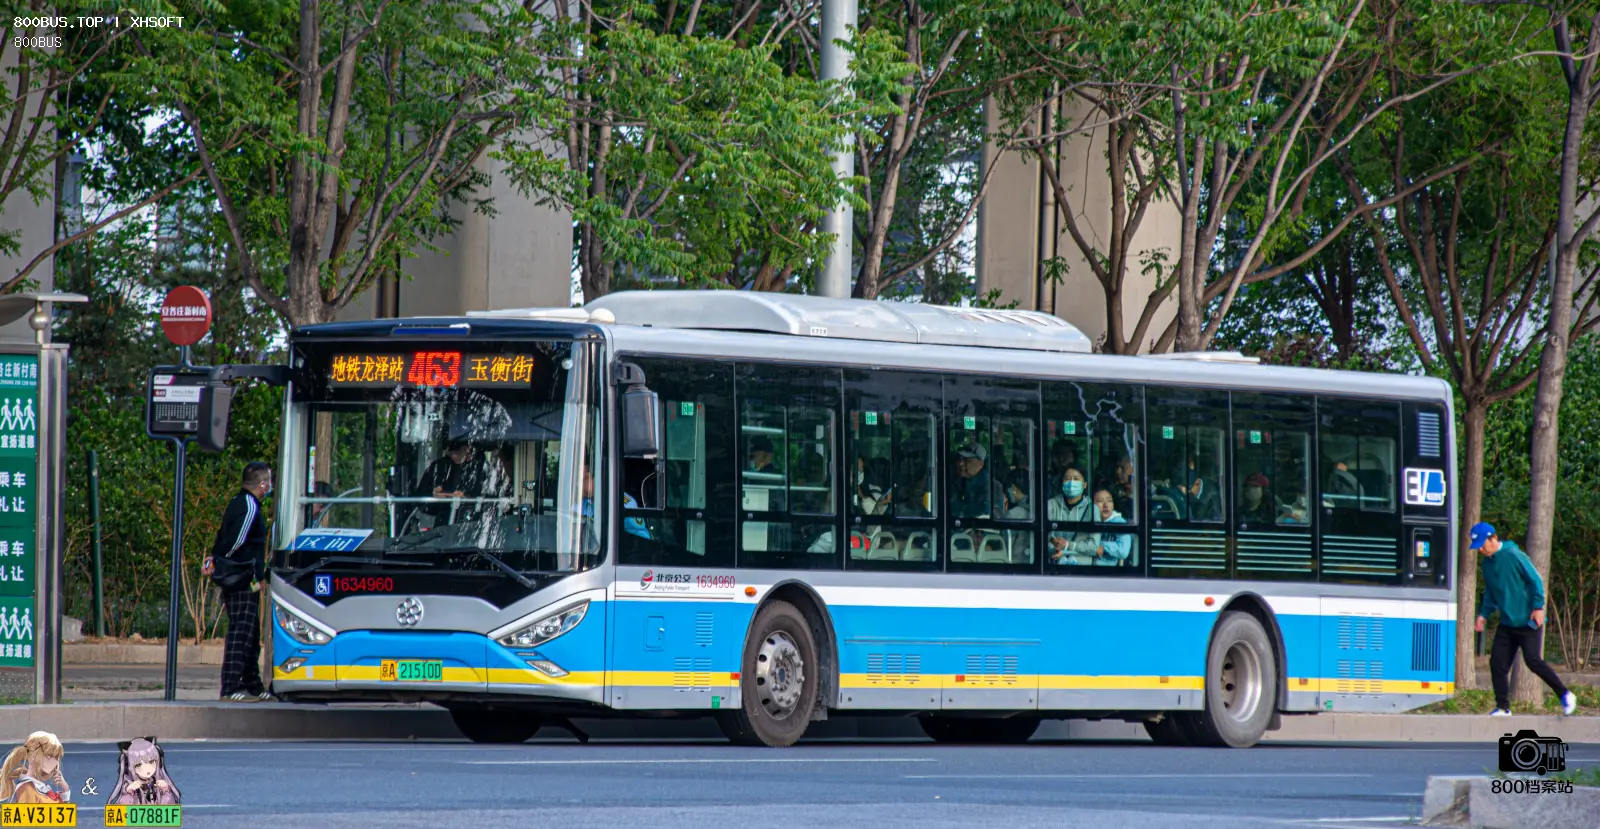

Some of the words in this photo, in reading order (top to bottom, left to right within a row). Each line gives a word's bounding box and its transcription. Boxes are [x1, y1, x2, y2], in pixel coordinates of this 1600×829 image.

[331, 355, 404, 383] 地铁龙泽站
[408, 351, 462, 387] 463
[467, 355, 534, 383] 玉衡街
[0, 471, 26, 488] 乘车
[333, 577, 394, 592] 1634960
[655, 573, 692, 583] 北京公交
[695, 574, 736, 589] 1634960
